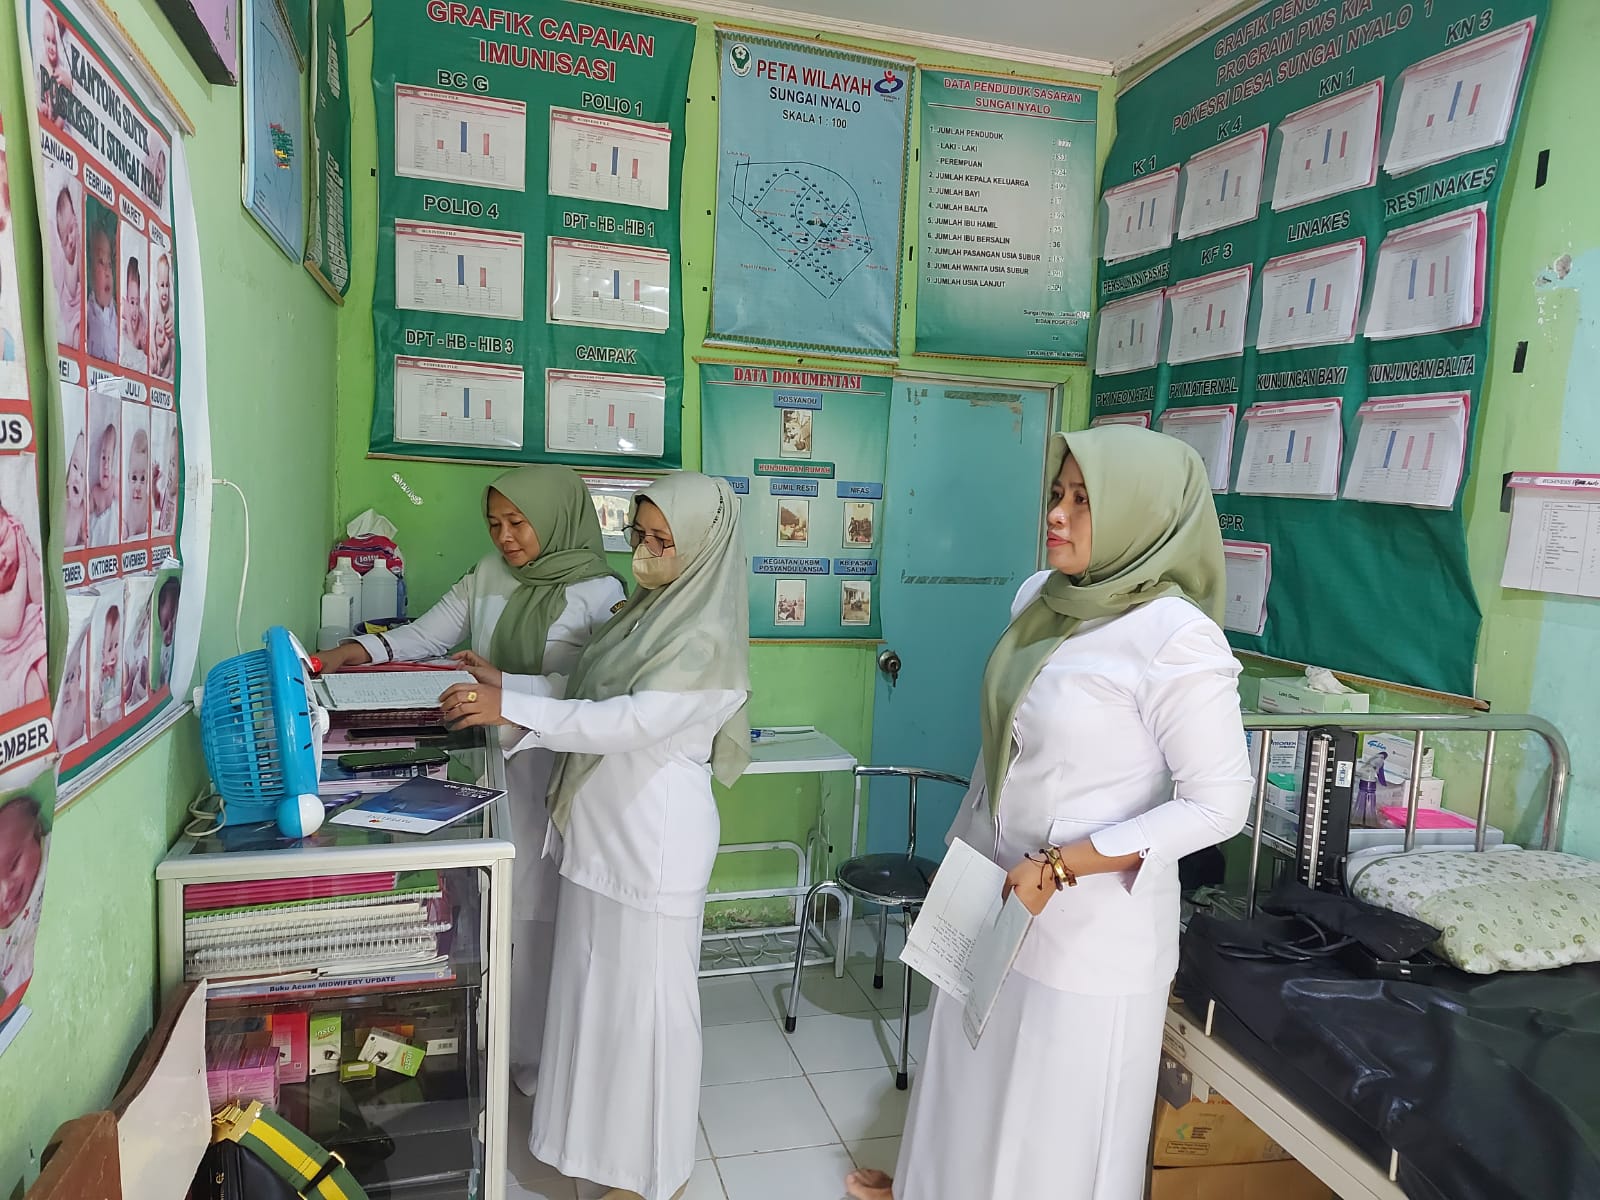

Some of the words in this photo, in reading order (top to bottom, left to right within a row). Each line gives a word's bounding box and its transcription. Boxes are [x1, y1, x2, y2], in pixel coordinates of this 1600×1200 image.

[426, 0, 533, 36] GRAFIK
[538, 18, 655, 57] CAPAIAN
[1214, 12, 1270, 60] GRAFIK
[1445, 15, 1475, 46] KN
[1480, 8, 1494, 32] 3
[1216, 31, 1294, 86] PROGRAM
[1297, 10, 1337, 44] PWS
[1340, 0, 1372, 24] KIA
[479, 40, 616, 82] IMUNISASI
[1172, 90, 1231, 135] POKESRI
[1233, 70, 1274, 106] DESA
[1276, 35, 1344, 83] SUNGAI
[1346, 4, 1413, 53] NYALO
[70, 43, 122, 129] KANTONG
[437, 69, 468, 88] BC
[473, 76, 489, 92] G
[756, 59, 798, 84] PETA
[802, 66, 872, 96] WILAYAH
[1318, 72, 1343, 98] KN
[1346, 67, 1354, 86] 1
[769, 86, 817, 106] SUNGAI
[820, 97, 861, 113] NYALO
[944, 78, 971, 90] DATA
[974, 81, 1031, 97] PENDUDUK
[1033, 88, 1082, 104] SASARAN
[581, 92, 631, 114] POLIO
[634, 101, 642, 116] 1
[975, 98, 1015, 110] SUNGAI
[1018, 104, 1051, 114] NYALO
[782, 110, 815, 124] SKALA
[818, 115, 823, 125] 1
[832, 117, 847, 128] 100
[1217, 123, 1230, 140] K
[1231, 116, 1242, 133] 4
[937, 127, 964, 136] JUMLAH
[966, 130, 1004, 140] PENDUDUK
[41, 133, 74, 170] JANUARI
[106, 129, 140, 188] SUNGAI
[940, 158, 983, 168] PEREMPUAN
[1132, 160, 1146, 176] K
[1148, 155, 1156, 170] 1
[85, 168, 113, 202] FEBRUARI
[936, 172, 964, 181] JUMLAH
[965, 175, 992, 184] KEPALA
[993, 178, 1029, 187] KELUARGA
[1385, 184, 1431, 217] RESTI
[1432, 164, 1497, 202] NAKES
[935, 188, 963, 196] JUMLAH
[122, 200, 141, 226] MARET
[424, 195, 484, 217] POLIO
[487, 203, 499, 220] 4
[935, 203, 963, 212] JUMLAH
[563, 212, 588, 230] DPT
[598, 215, 615, 233] HB
[624, 218, 647, 236] HIB
[648, 222, 655, 237] 1
[934, 218, 962, 227] JUMLAH
[1287, 210, 1351, 243] LINAKES
[934, 233, 962, 241] JUMLAH
[976, 236, 1010, 244] BERSALIN
[934, 248, 962, 256] JUMLAH
[963, 250, 1000, 258] PASANGAN
[1018, 253, 1040, 261] SUBUR
[1201, 246, 1220, 265] KF
[1222, 243, 1233, 260] 3
[934, 263, 961, 271] JUMLAH
[1007, 266, 1029, 274] SUBUR
[405, 330, 436, 346] DPT
[446, 334, 467, 350] HB
[478, 336, 503, 352] HIB
[504, 338, 514, 354] 3
[576, 345, 637, 364] CAMPAK
[734, 368, 768, 382] DATA
[772, 370, 862, 389] DOKUMENTASI
[1256, 368, 1316, 391] KUNJUNGAN
[1317, 366, 1348, 385] BAYI
[1368, 358, 1436, 384] KUNJUNGAN
[1436, 354, 1476, 378] BALITA
[125, 382, 140, 398] JULI
[1110, 386, 1154, 406] NEONATAL
[1183, 377, 1239, 397] MATERNAL
[778, 396, 817, 404] POSYANDU
[91, 558, 118, 576] OKTOBER
[318, 978, 364, 988] MIDWIFERY
[366, 976, 396, 984] UPDATE
